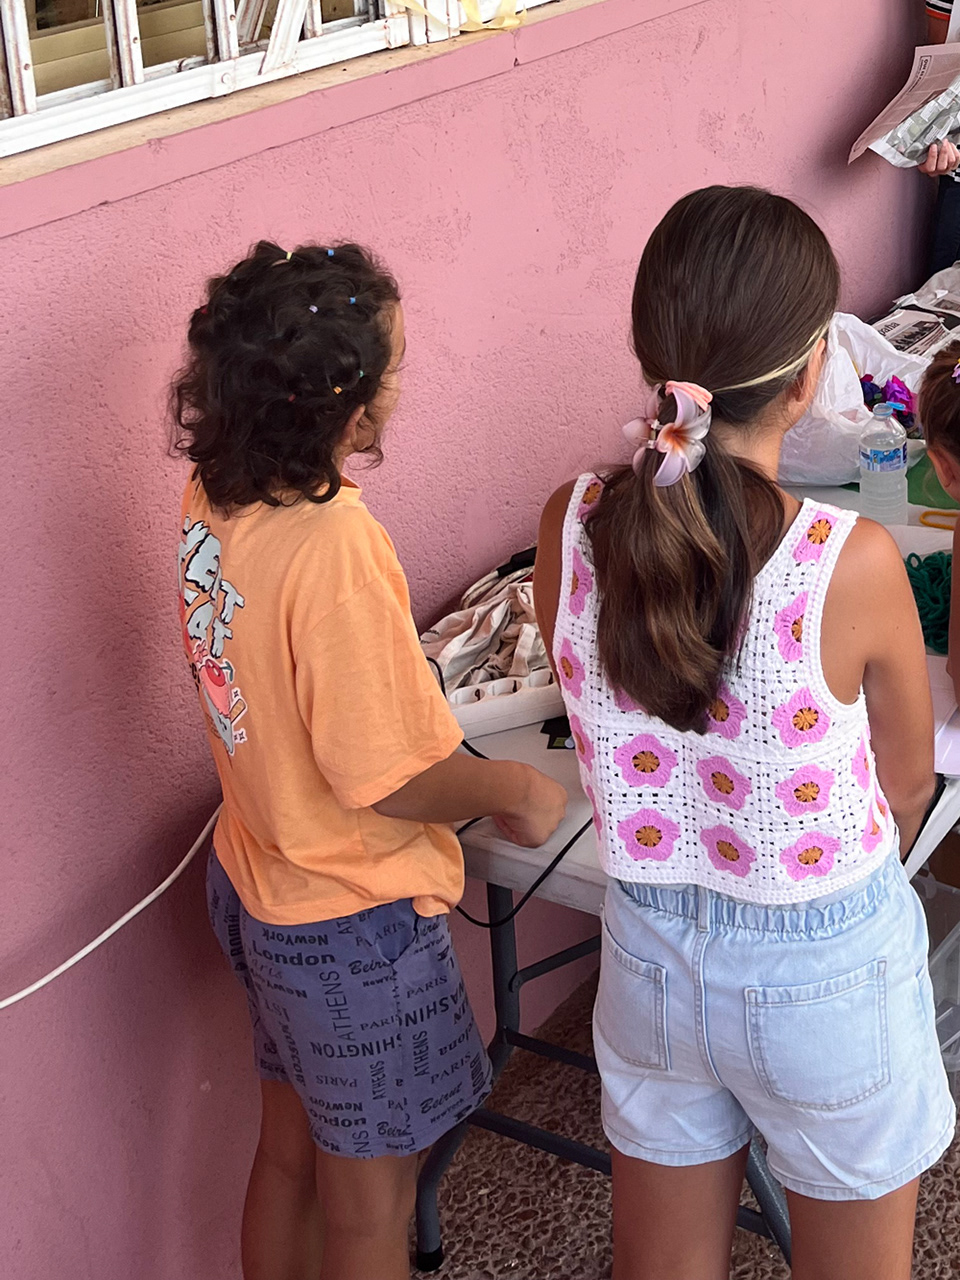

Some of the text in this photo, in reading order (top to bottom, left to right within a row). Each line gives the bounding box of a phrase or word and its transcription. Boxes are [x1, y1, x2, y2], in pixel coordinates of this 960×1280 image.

[261, 927, 329, 946] NewYork
[252, 940, 336, 966] London
[406, 975, 448, 999] PARIS
[319, 971, 356, 1041] ATHENS
[398, 981, 467, 1028] WASHIN
[412, 1030, 430, 1078] ATHENS
[430, 1052, 471, 1084] PARIS
[315, 1075, 358, 1088] PARIS
[370, 1060, 387, 1100] ATHENS
[308, 1108, 367, 1128] ondon
